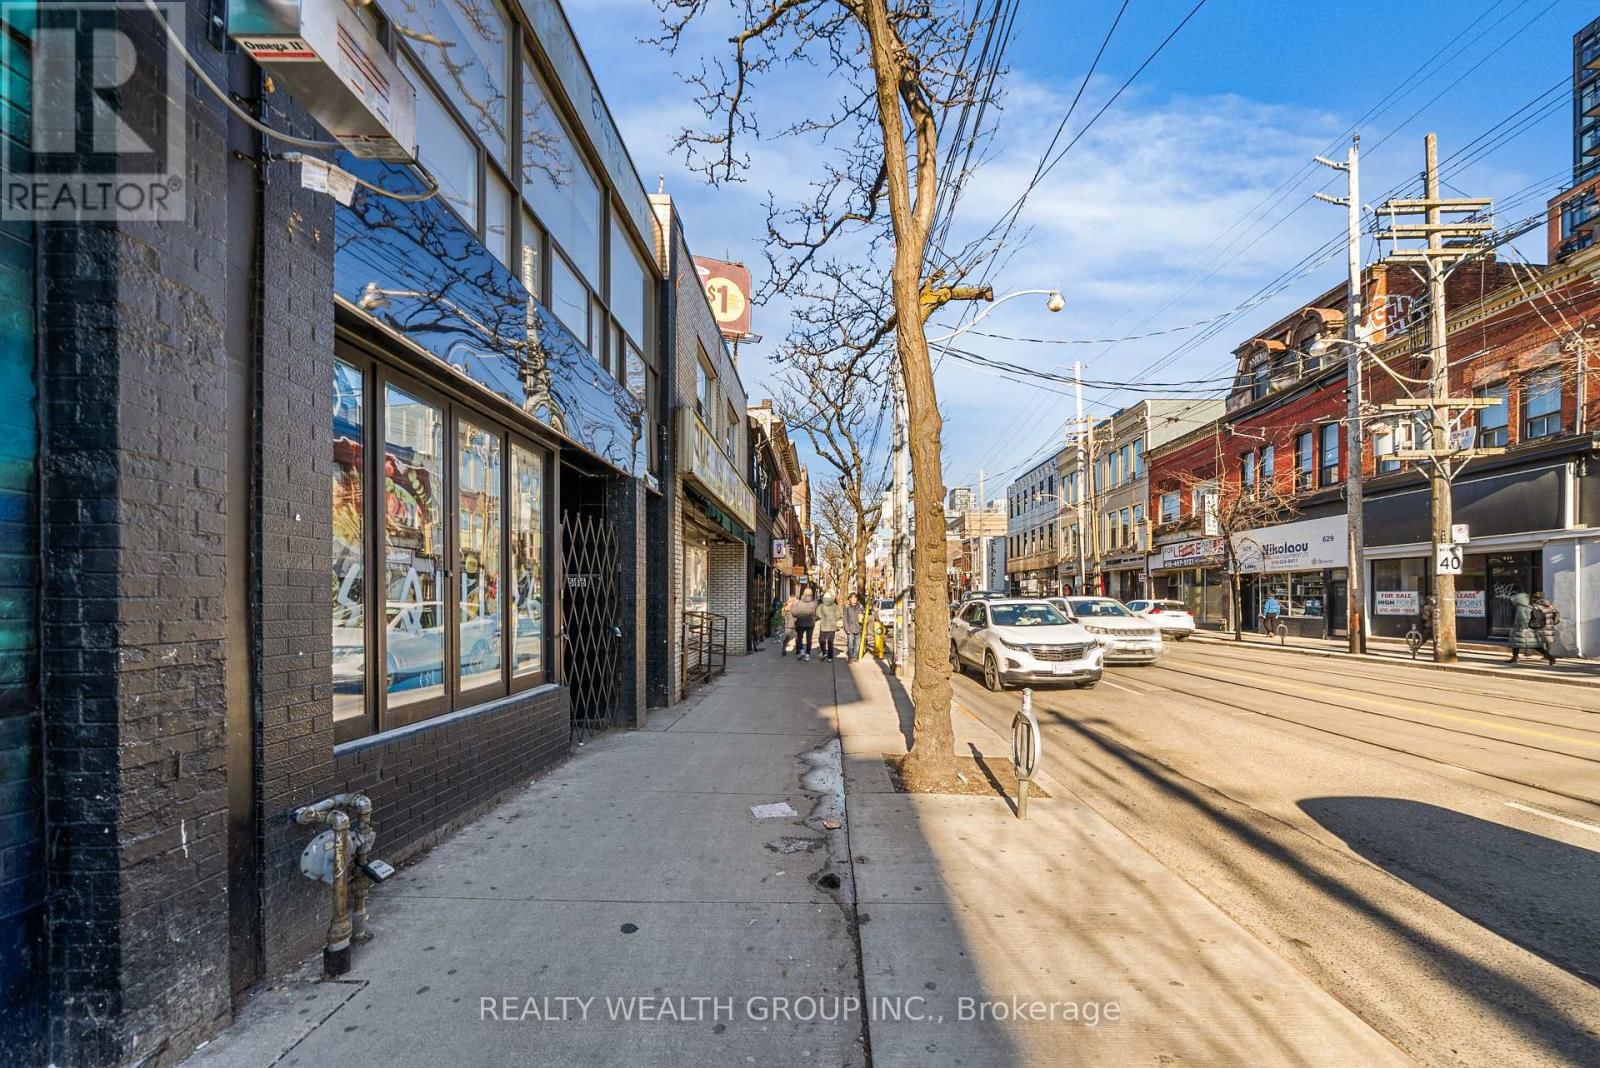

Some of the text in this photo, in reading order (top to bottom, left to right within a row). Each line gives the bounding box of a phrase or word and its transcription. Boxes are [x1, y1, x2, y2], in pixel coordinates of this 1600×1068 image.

[244, 41, 288, 52] Omega
[708, 285, 728, 313] $1
[1262, 542, 1308, 556] Nikolaou
[1440, 557, 1460, 570] 40
